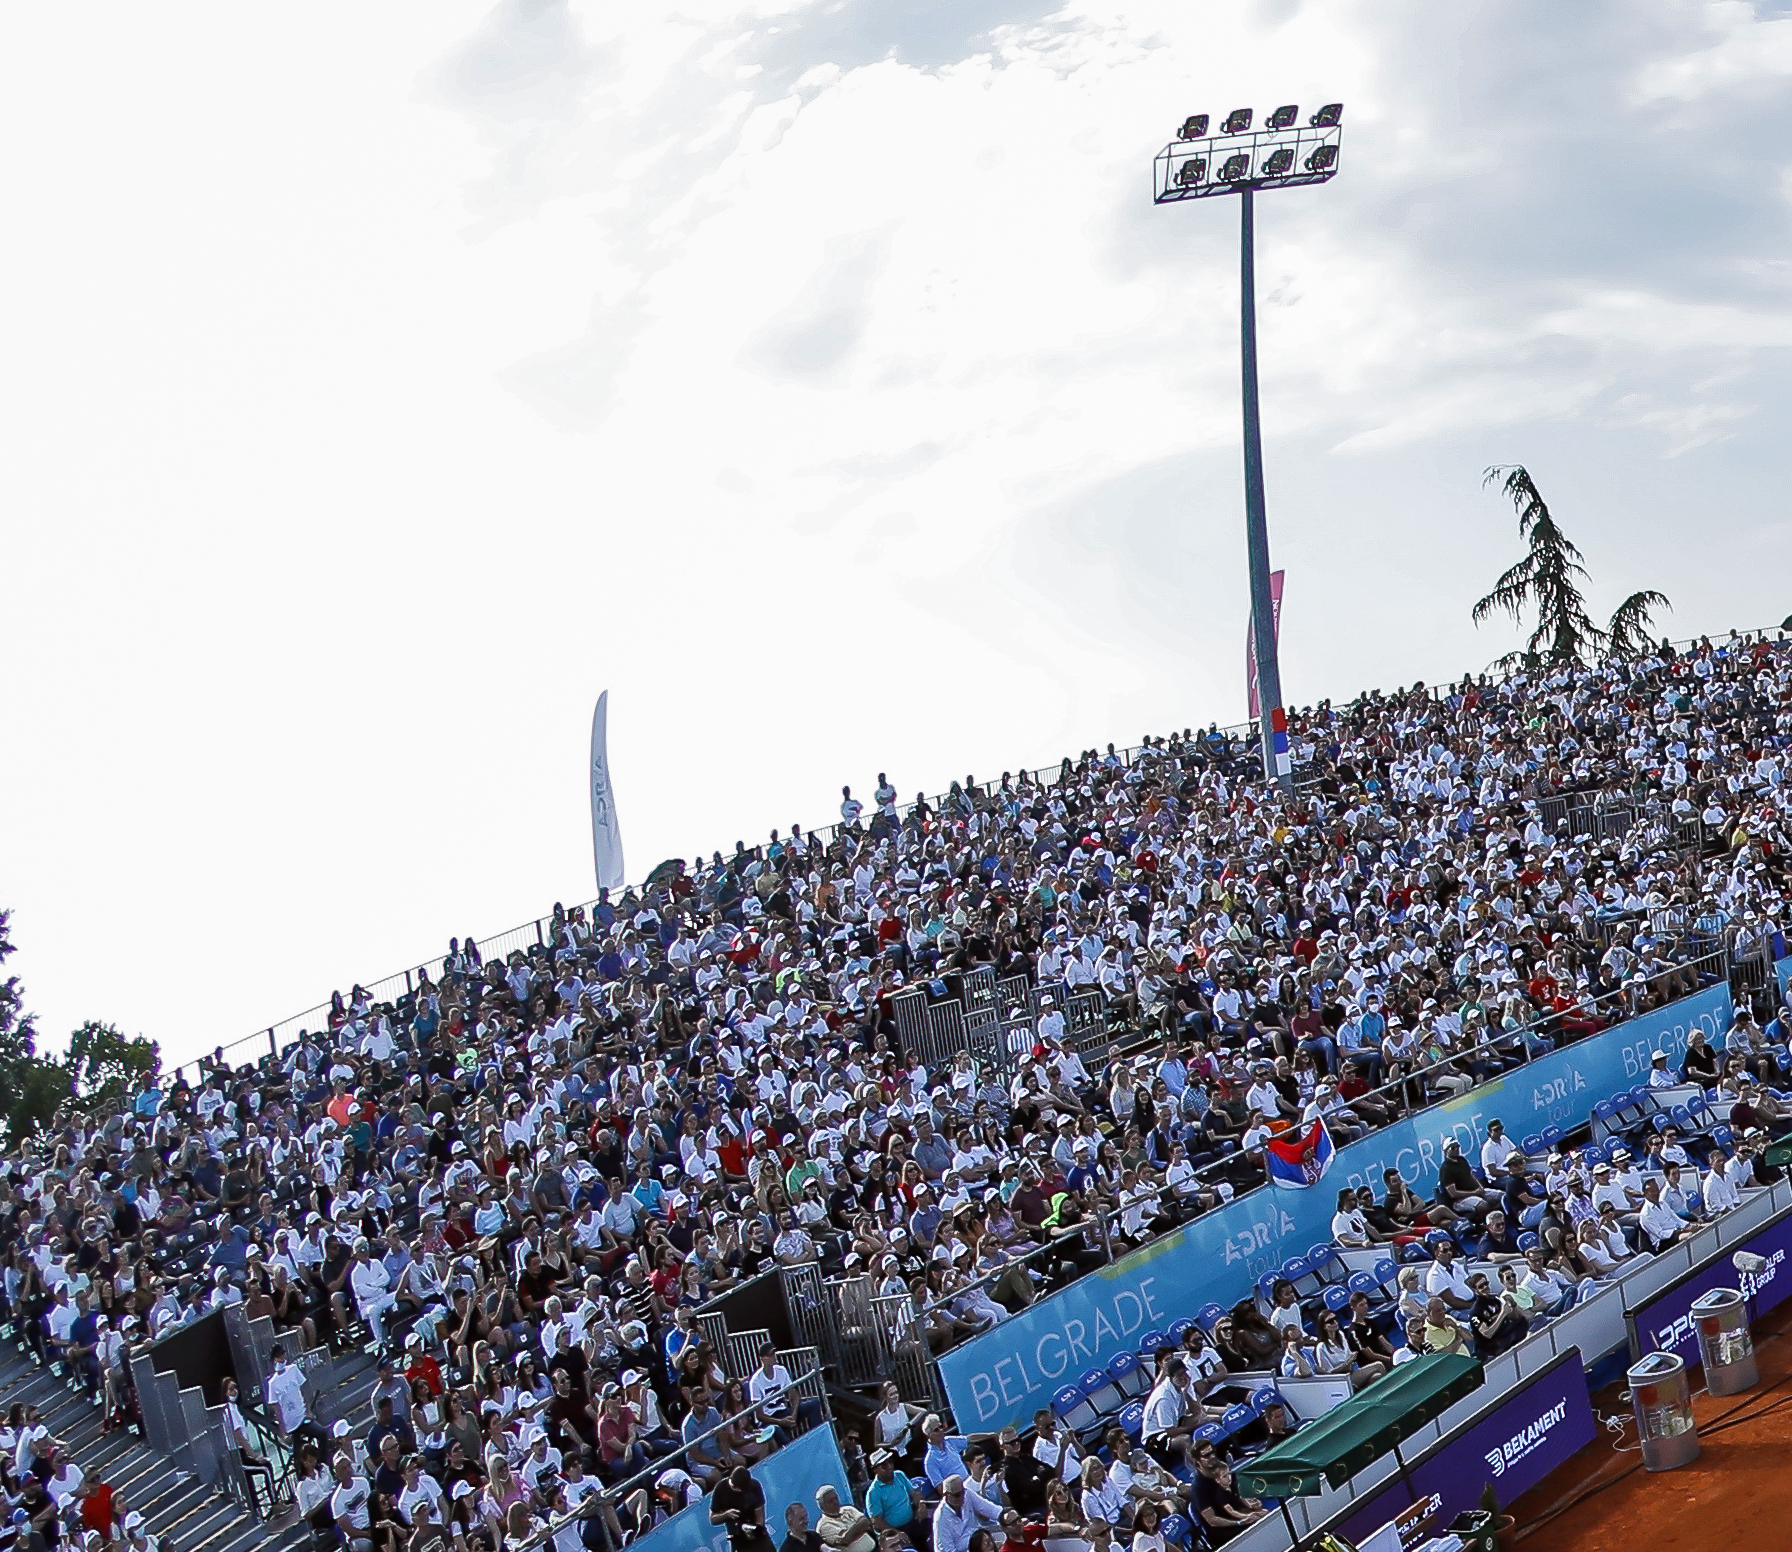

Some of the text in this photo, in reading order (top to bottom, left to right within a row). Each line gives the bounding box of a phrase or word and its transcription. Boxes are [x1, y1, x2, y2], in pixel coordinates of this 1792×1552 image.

[1530, 1062, 1588, 1111] ADRIA
[1347, 1112, 1485, 1203] BEGRDE
[1222, 1202, 1297, 1266] ADRIA
[1245, 1245, 1284, 1281] tour
[1756, 1267, 1777, 1290] GROUP
[968, 1276, 1166, 1423] BELGRADE
[1503, 1398, 1568, 1460] BEKAMENT
